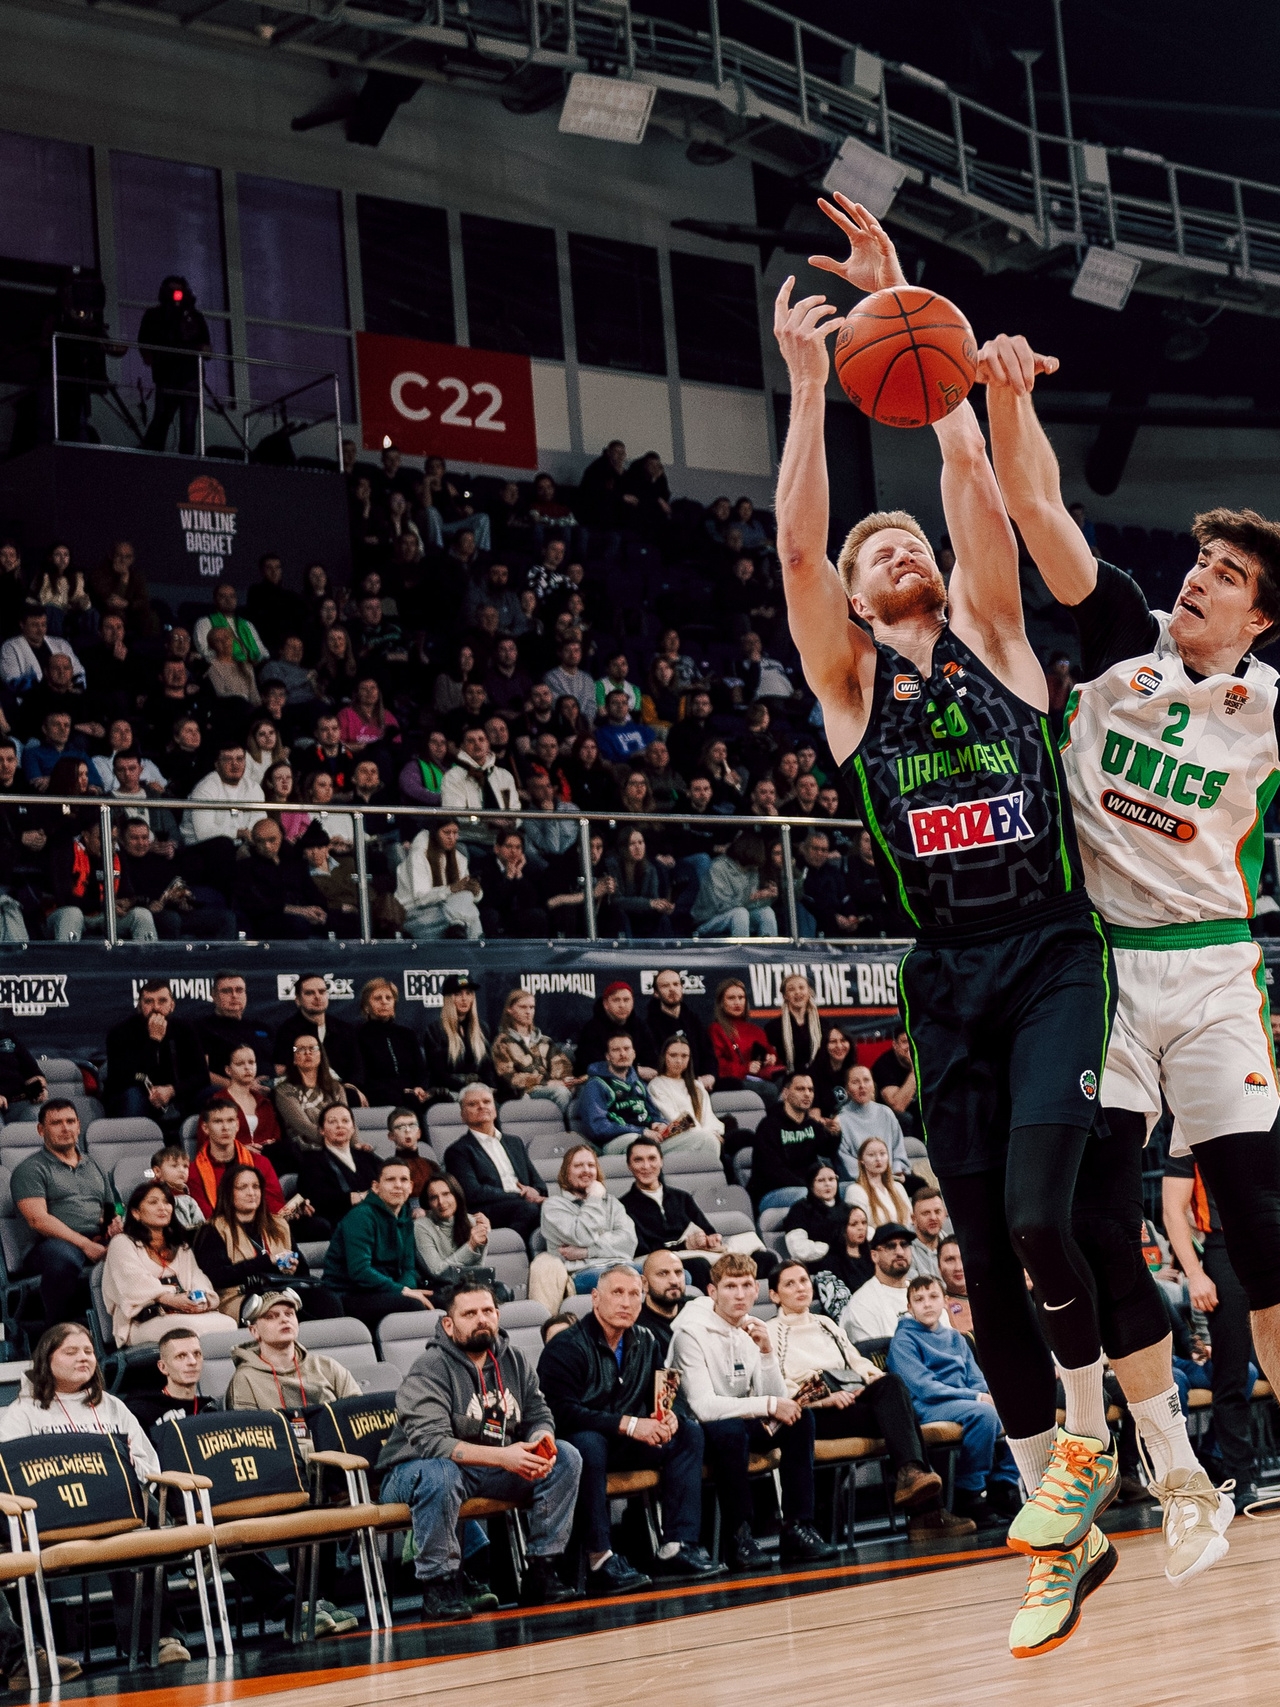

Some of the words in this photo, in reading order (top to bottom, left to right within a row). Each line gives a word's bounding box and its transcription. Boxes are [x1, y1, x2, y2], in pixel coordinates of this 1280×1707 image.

[390, 371, 506, 432] C22
[180, 509, 237, 534] WINLINE
[186, 531, 233, 555] BASKET
[199, 555, 224, 576] CUP
[1138, 674, 1160, 690] WIN
[1161, 702, 1190, 747] 2
[897, 740, 1019, 796] URALMASH
[1101, 729, 1230, 809] UNICS
[911, 796, 1032, 854] BROZEX
[1107, 794, 1177, 833] WINLINE
[350, 1412, 399, 1440] URALM
[198, 1429, 277, 1460] URALMASH
[20, 1456, 108, 1487] URALMASH
[231, 1456, 258, 1482] 39
[57, 1483, 88, 1508] 40
